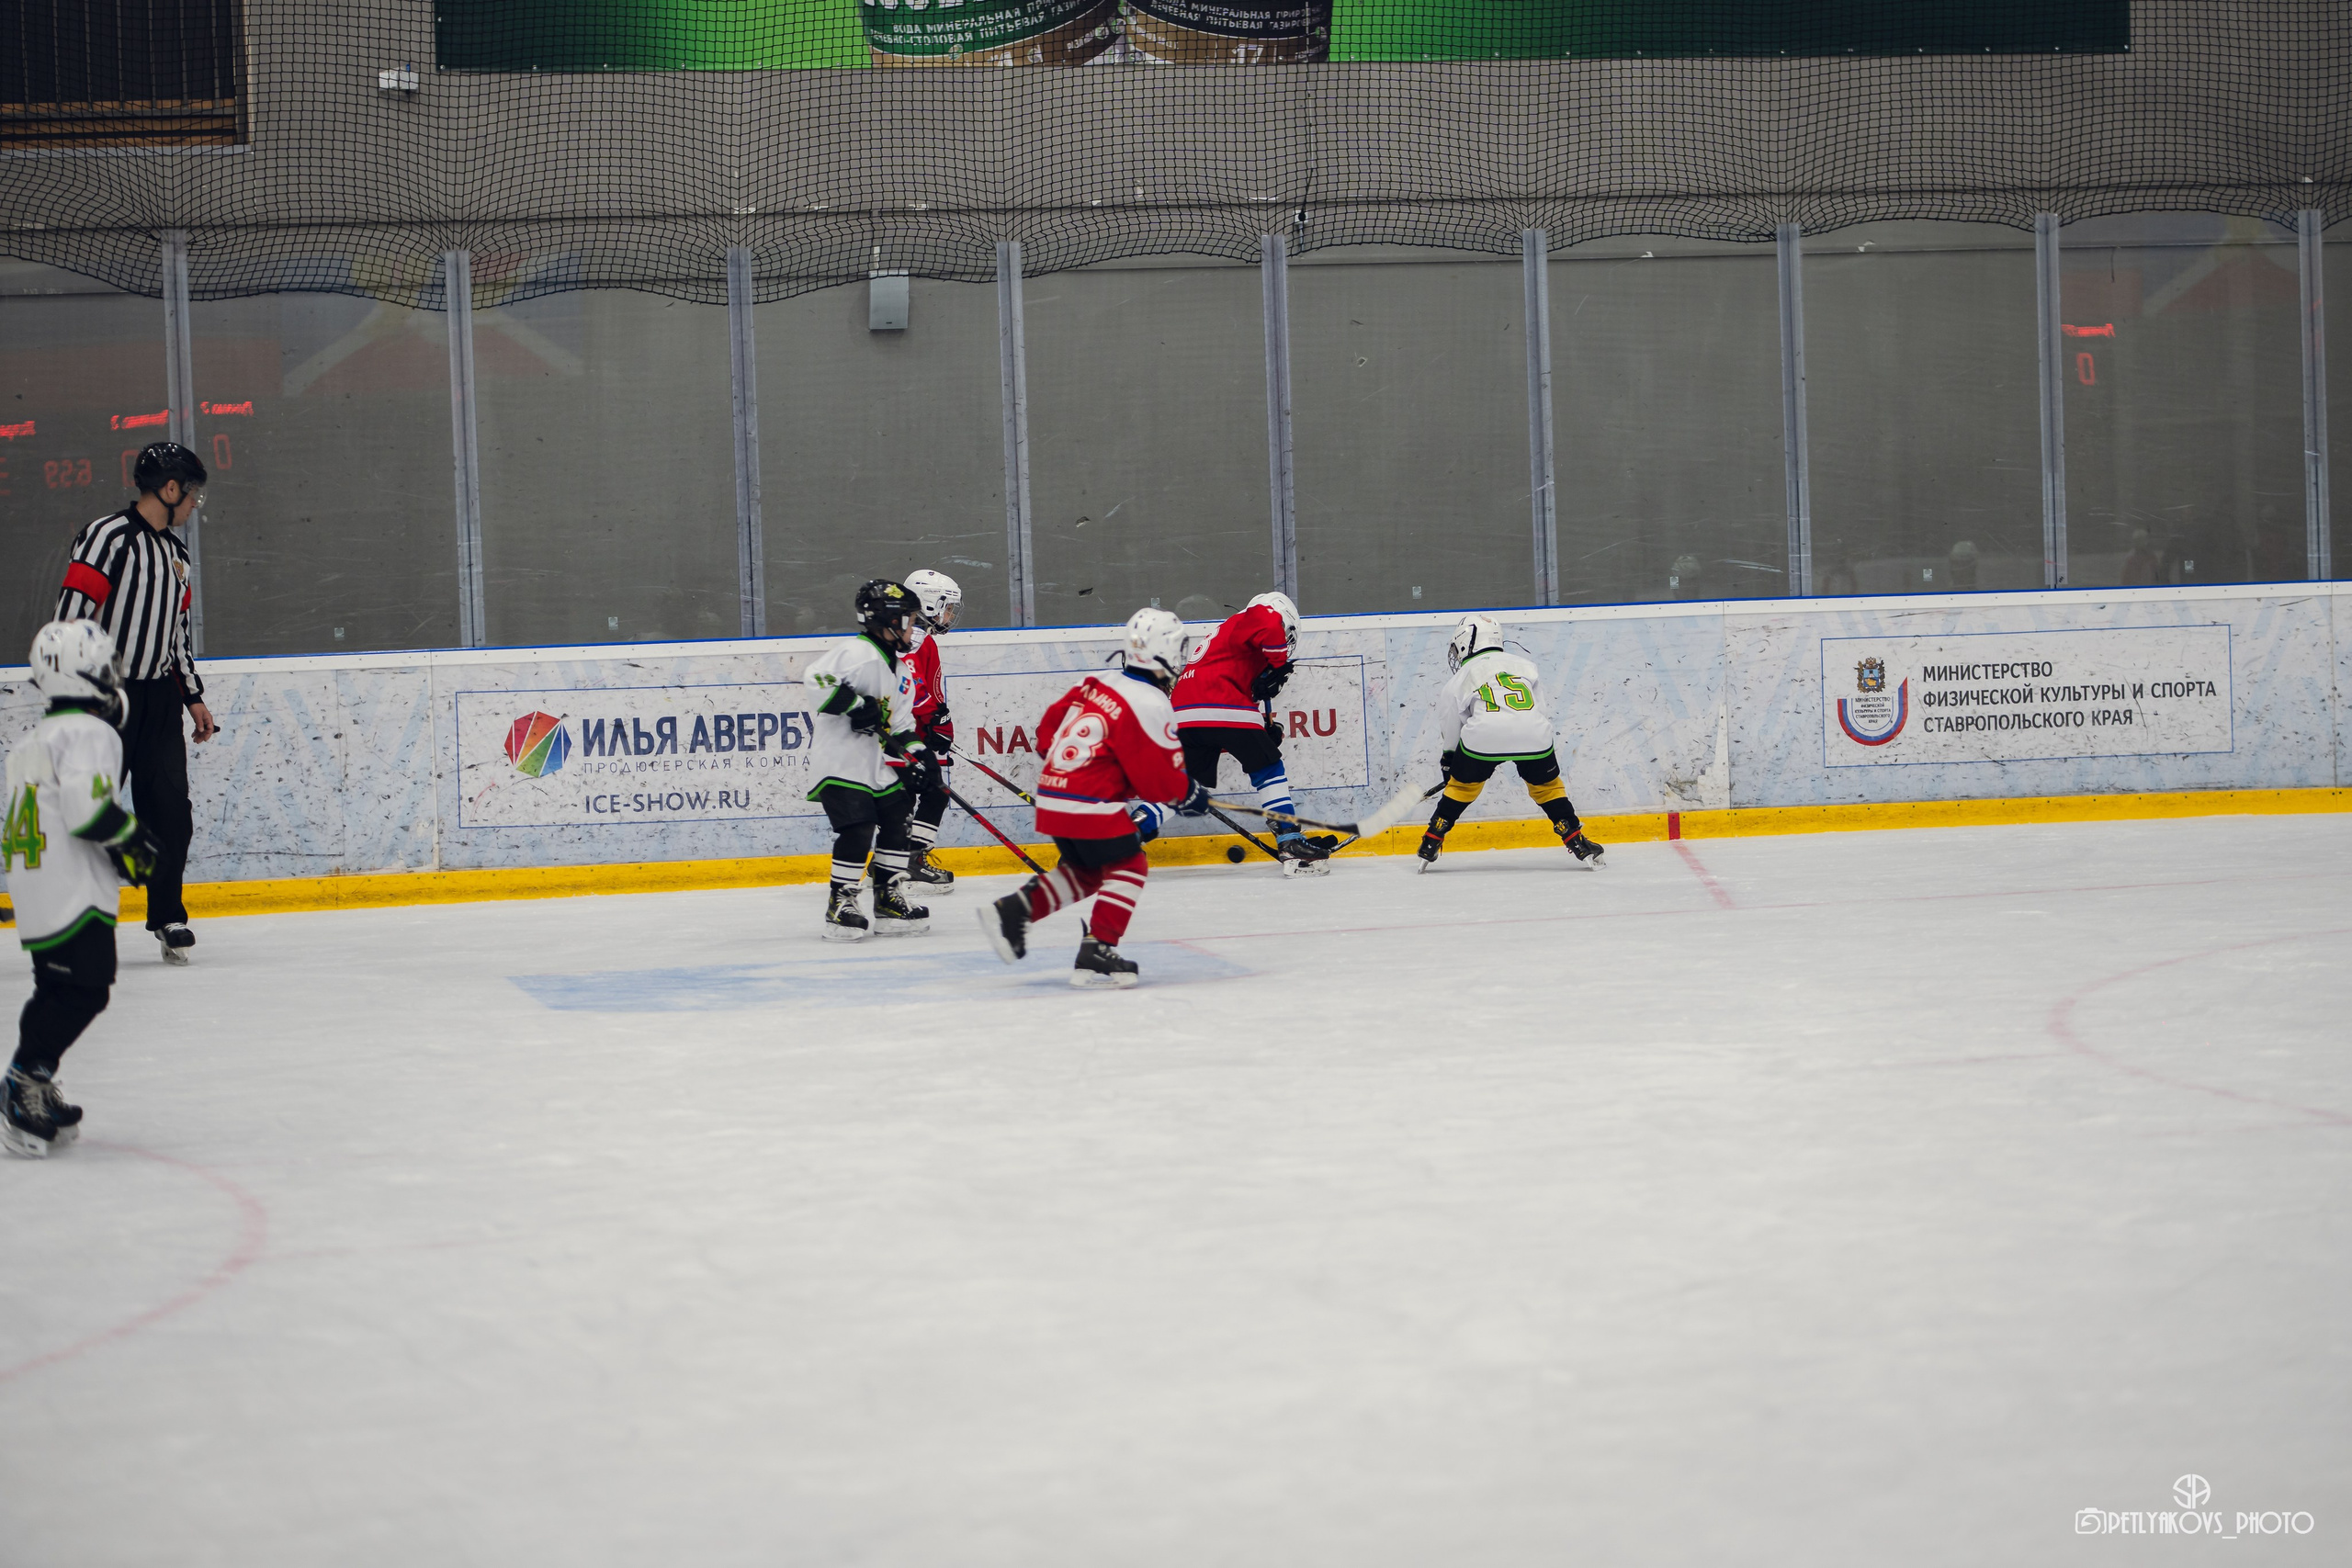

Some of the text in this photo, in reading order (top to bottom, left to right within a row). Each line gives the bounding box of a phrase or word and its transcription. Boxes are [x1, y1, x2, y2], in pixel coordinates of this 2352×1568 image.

[1923, 660, 2053, 682] МИНИСТЕРСТВО
[1473, 671, 1535, 712] 15
[1923, 681, 2217, 707] ФИЗИЧЕСКОЙ КУЛЬТУРЫ И СПОРТА
[1923, 709, 2133, 733] СТАВРОПОЛЬСКОГО КРАЯ
[582, 711, 816, 758] ИЛЬЯ АВЕРБУ
[583, 757, 811, 774] ПРОДЮСЕРСКАЯ КОМПА
[584, 789, 751, 815] ICE-SHOW.RU
